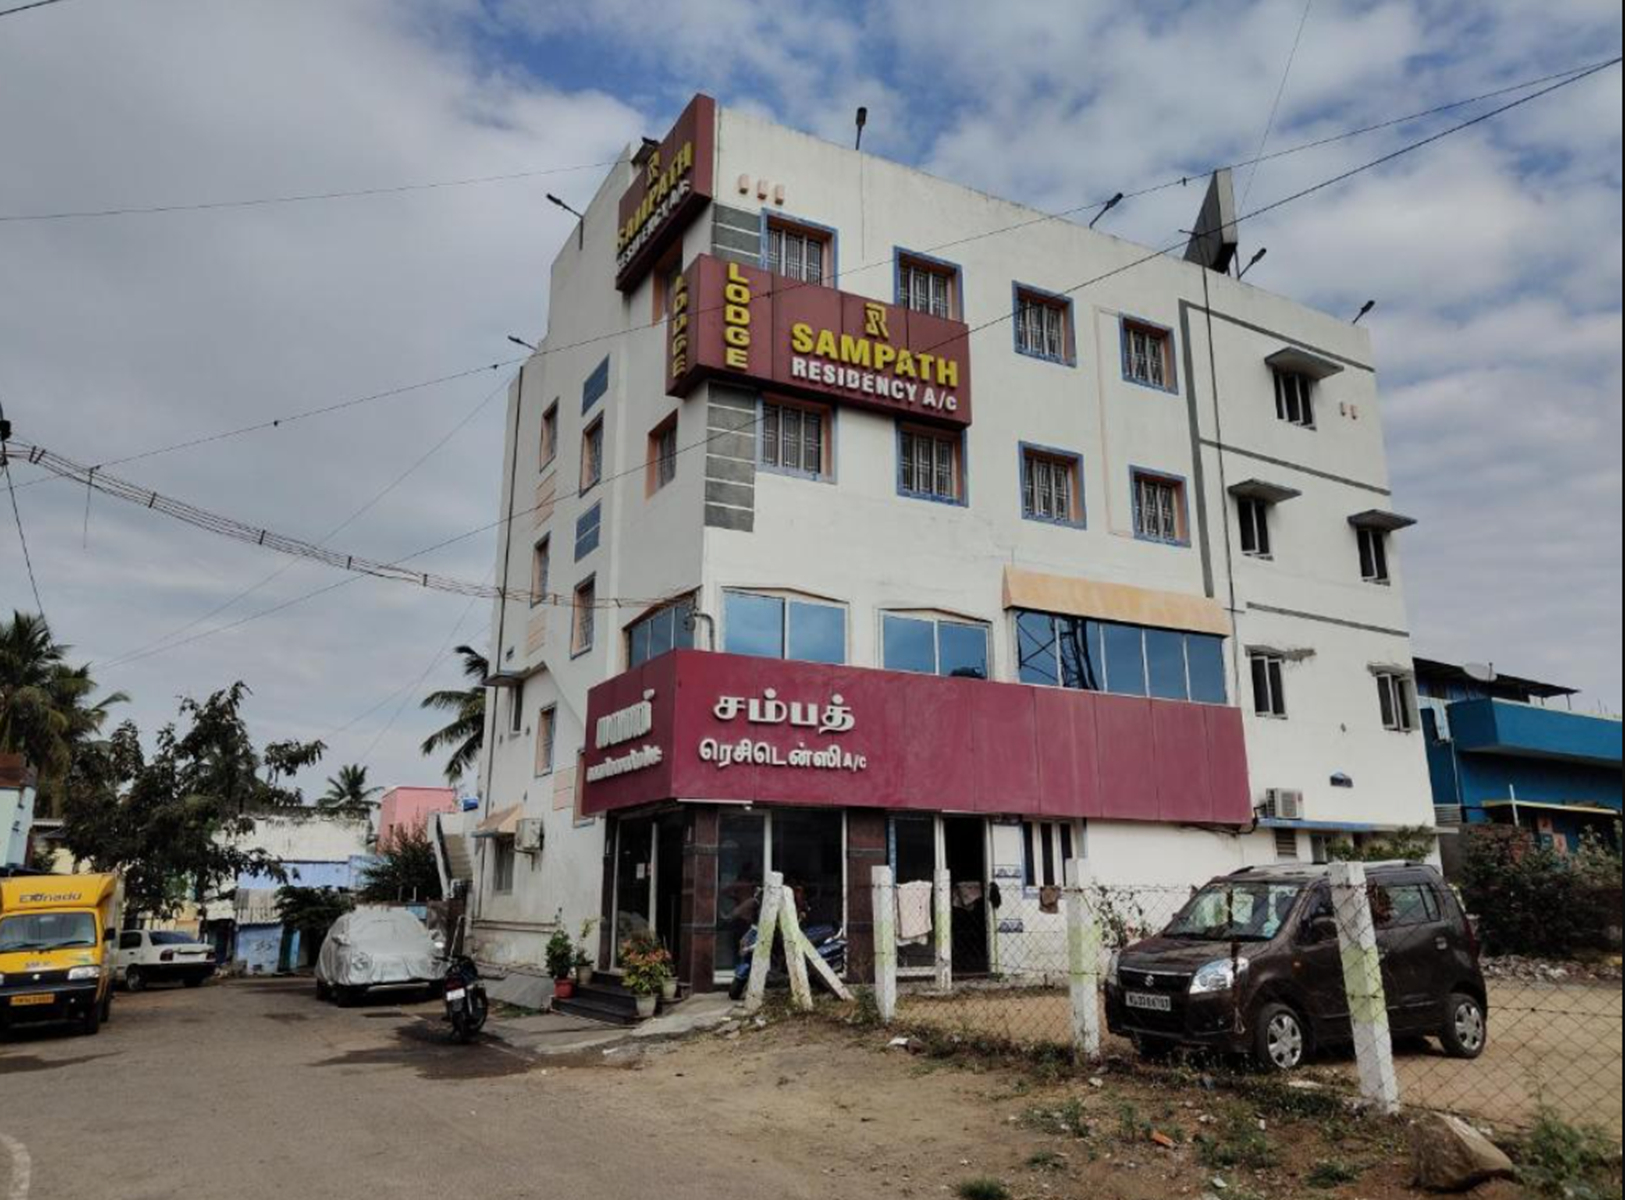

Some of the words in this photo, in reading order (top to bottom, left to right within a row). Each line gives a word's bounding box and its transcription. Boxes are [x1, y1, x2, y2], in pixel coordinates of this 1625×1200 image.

[725, 262, 750, 369] LODGE
[792, 323, 959, 387] SAMPATH
[792, 356, 918, 401] RESIDENCY
[713, 688, 855, 734] சம்பத்
